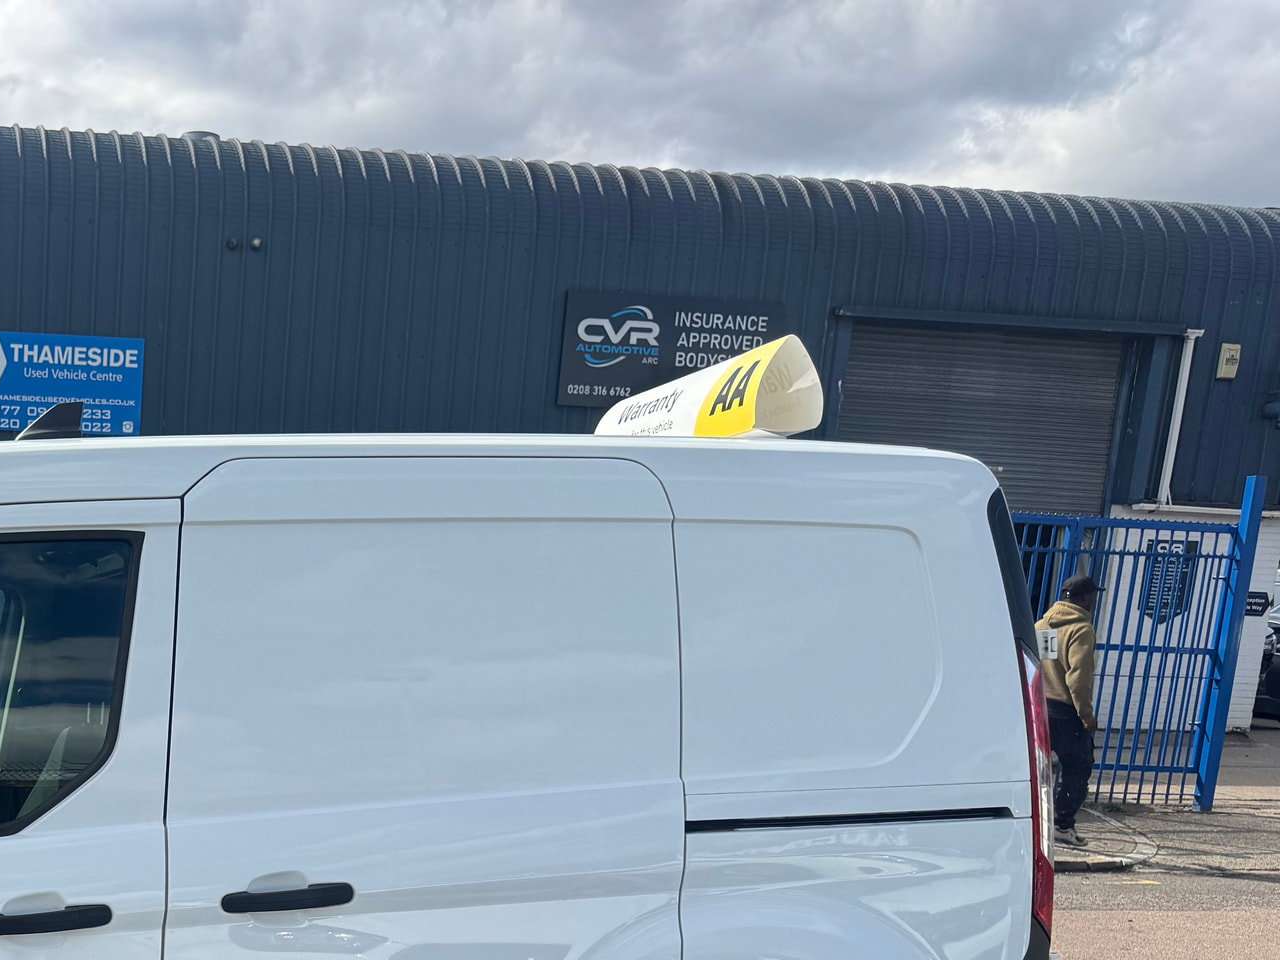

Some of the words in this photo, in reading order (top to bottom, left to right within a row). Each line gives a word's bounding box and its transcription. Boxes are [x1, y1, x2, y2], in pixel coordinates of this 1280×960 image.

[675, 311, 769, 332] INSURANCE
[577, 317, 660, 346] CVR
[575, 343, 659, 355] AUTOMOTIVE
[676, 332, 763, 351] APPROVED
[10, 343, 138, 368] THAMESIDE
[641, 357, 658, 365] ARC
[675, 352, 727, 368] BODYS
[23, 367, 49, 378] Used
[51, 368, 87, 381] Vehicle
[89, 371, 123, 382] Centre
[567, 384, 590, 395] 0208
[592, 385, 607, 396] 316
[609, 386, 631, 397] 6762
[709, 359, 761, 417] AA
[83, 408, 111, 420] 233
[618, 387, 684, 425] Warranty
